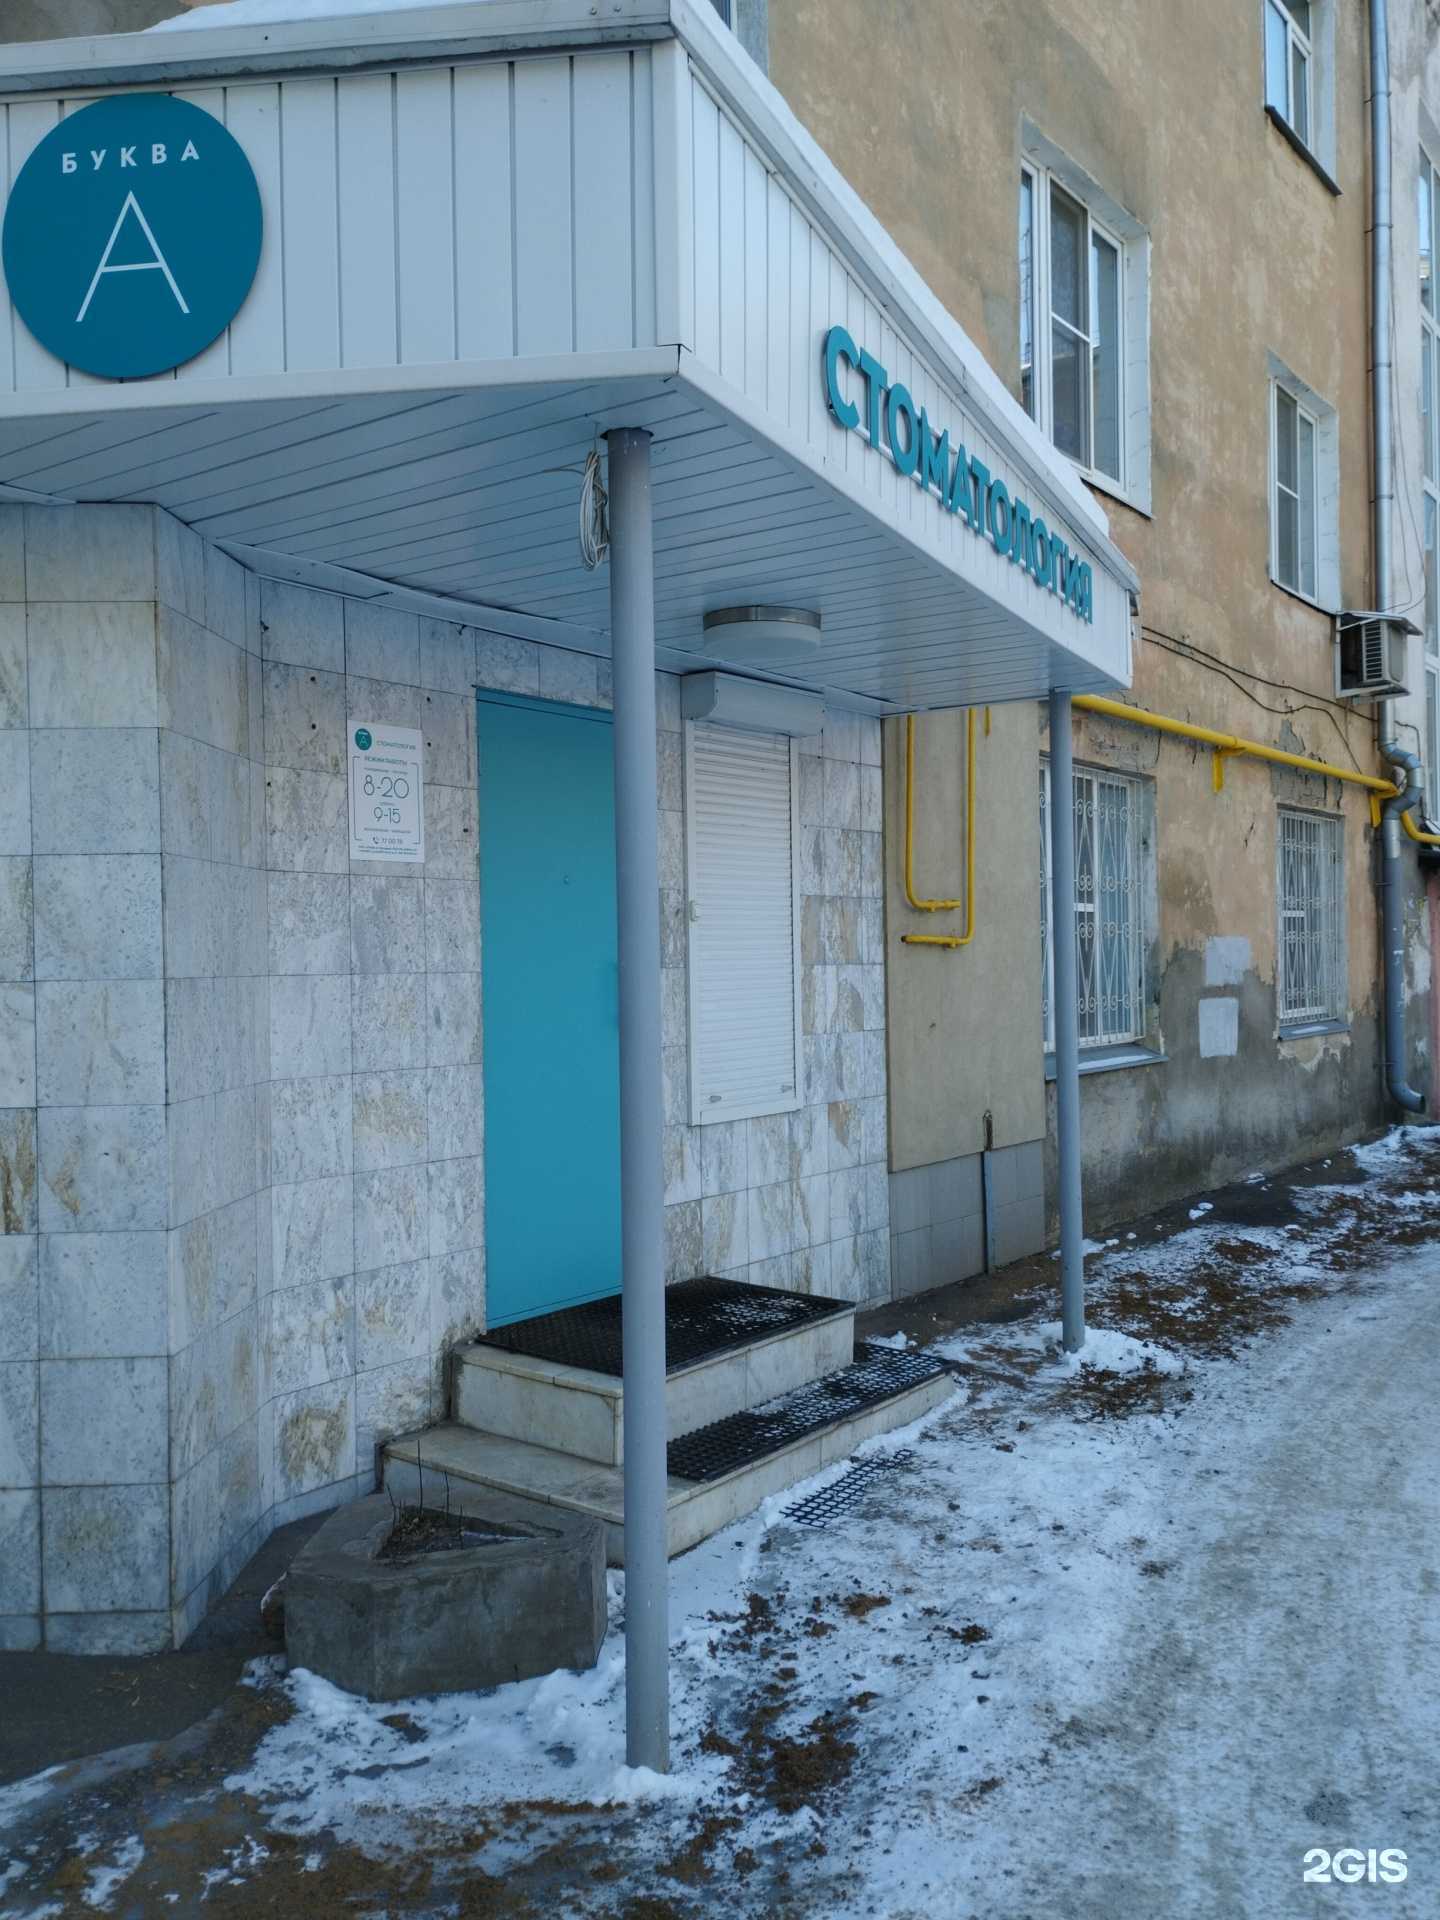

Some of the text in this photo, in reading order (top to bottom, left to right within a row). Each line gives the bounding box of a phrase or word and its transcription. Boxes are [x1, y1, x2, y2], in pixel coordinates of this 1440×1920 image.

[62, 139, 200, 174] БУКВА
[75, 190, 191, 322] А
[824, 325, 1093, 624] СТОМАТОЛОГИЯ
[363, 774, 410, 799] 8-20
[373, 806, 401, 824] 9-15
